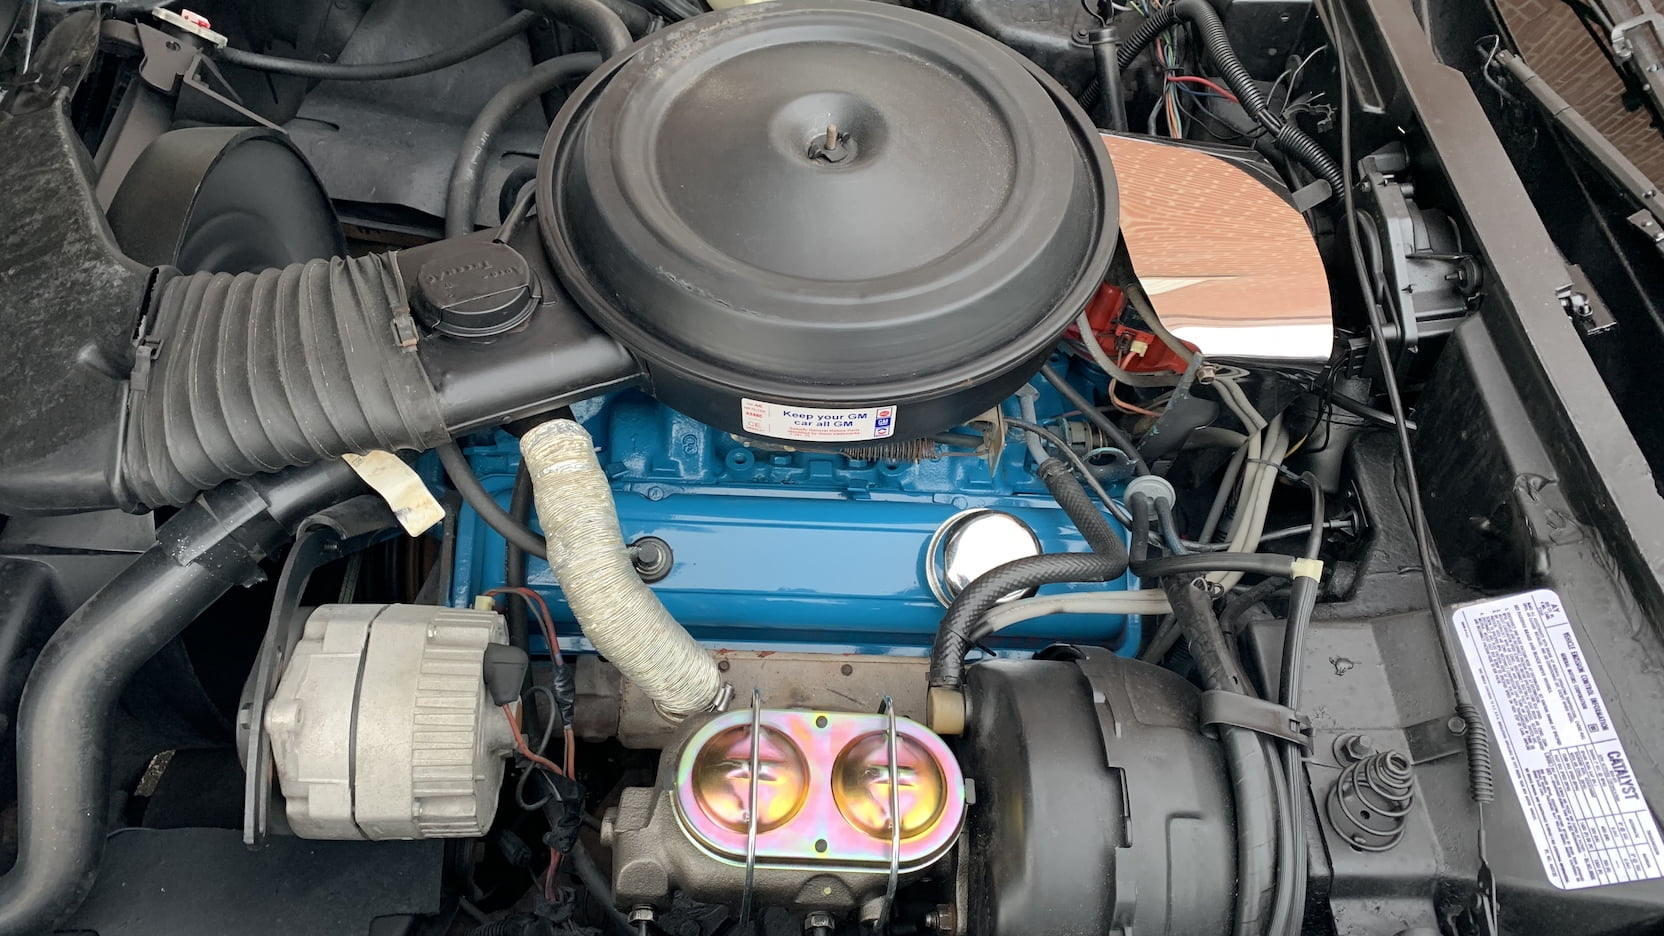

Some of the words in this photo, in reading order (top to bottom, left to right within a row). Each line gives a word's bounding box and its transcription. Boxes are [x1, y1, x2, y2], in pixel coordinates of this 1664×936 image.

[783, 410, 814, 420] Keep
[1562, 631, 1576, 650] VEHICLE
[1570, 650, 1585, 673] EMISSION
[1580, 673, 1595, 696] CONTROL
[1589, 696, 1609, 731] INFORMATION
[1607, 751, 1640, 801] CATALYST
